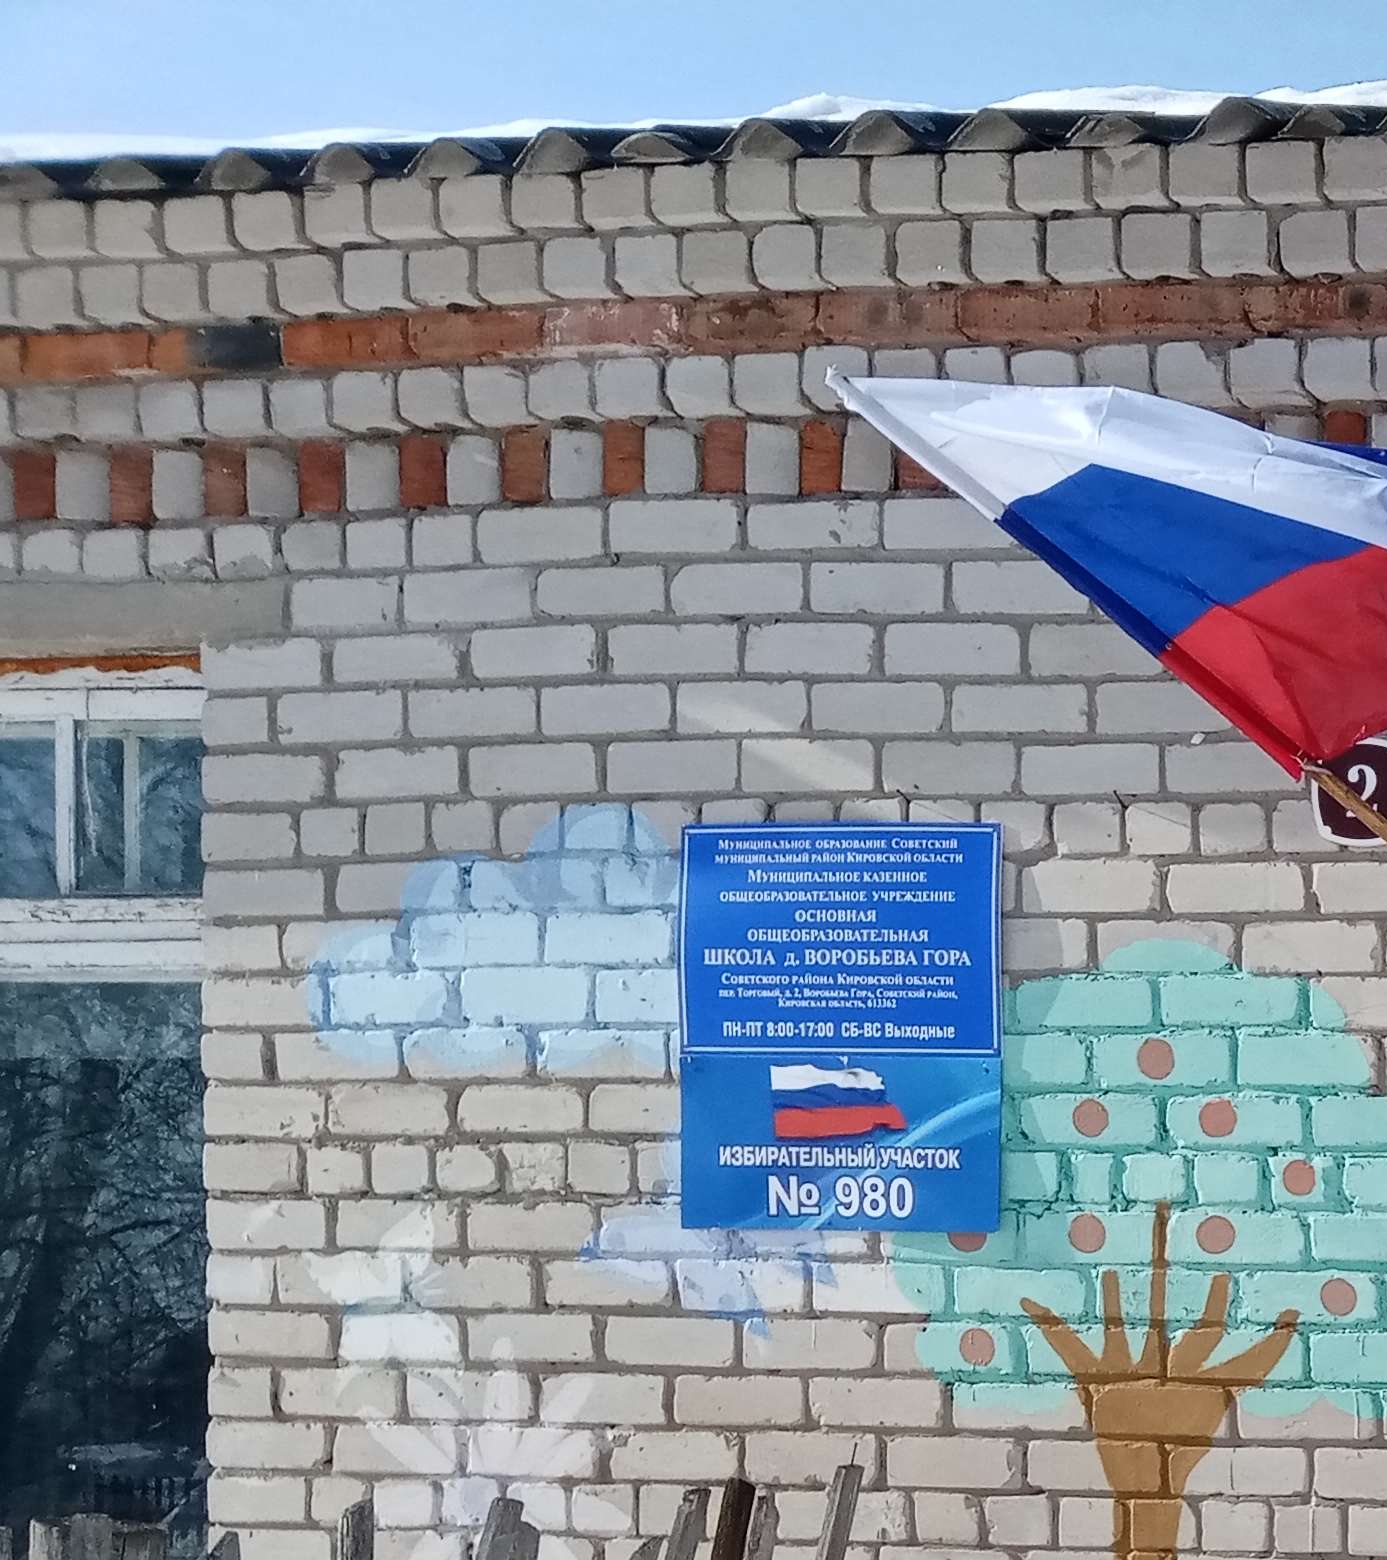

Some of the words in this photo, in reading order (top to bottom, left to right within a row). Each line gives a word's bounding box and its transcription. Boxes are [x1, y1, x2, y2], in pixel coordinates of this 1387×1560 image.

[1346, 763, 1379, 818] 2
[795, 909, 877, 922] ОСНОВНАЯ
[747, 928, 929, 943] ОБЩЕОБРАЗОВАТЕЛЬНАЯ
[704, 948, 776, 965] ШКОЛА
[784, 952, 800, 967] д.
[804, 949, 918, 966] ВОРОБЬЕВА
[922, 949, 972, 966] ГОРА
[722, 1021, 763, 1037] ПН-ПТ
[766, 1021, 834, 1037] 8:00-17:00
[841, 1022, 882, 1038] СБ-ВС
[884, 1022, 956, 1041] Выходные
[719, 1143, 876, 1168] ИЗБИРАТЕЛЬНЫЙ
[880, 1147, 961, 1170] УЧАСТОК
[768, 1175, 821, 1217] №
[835, 1176, 914, 1218] 980
